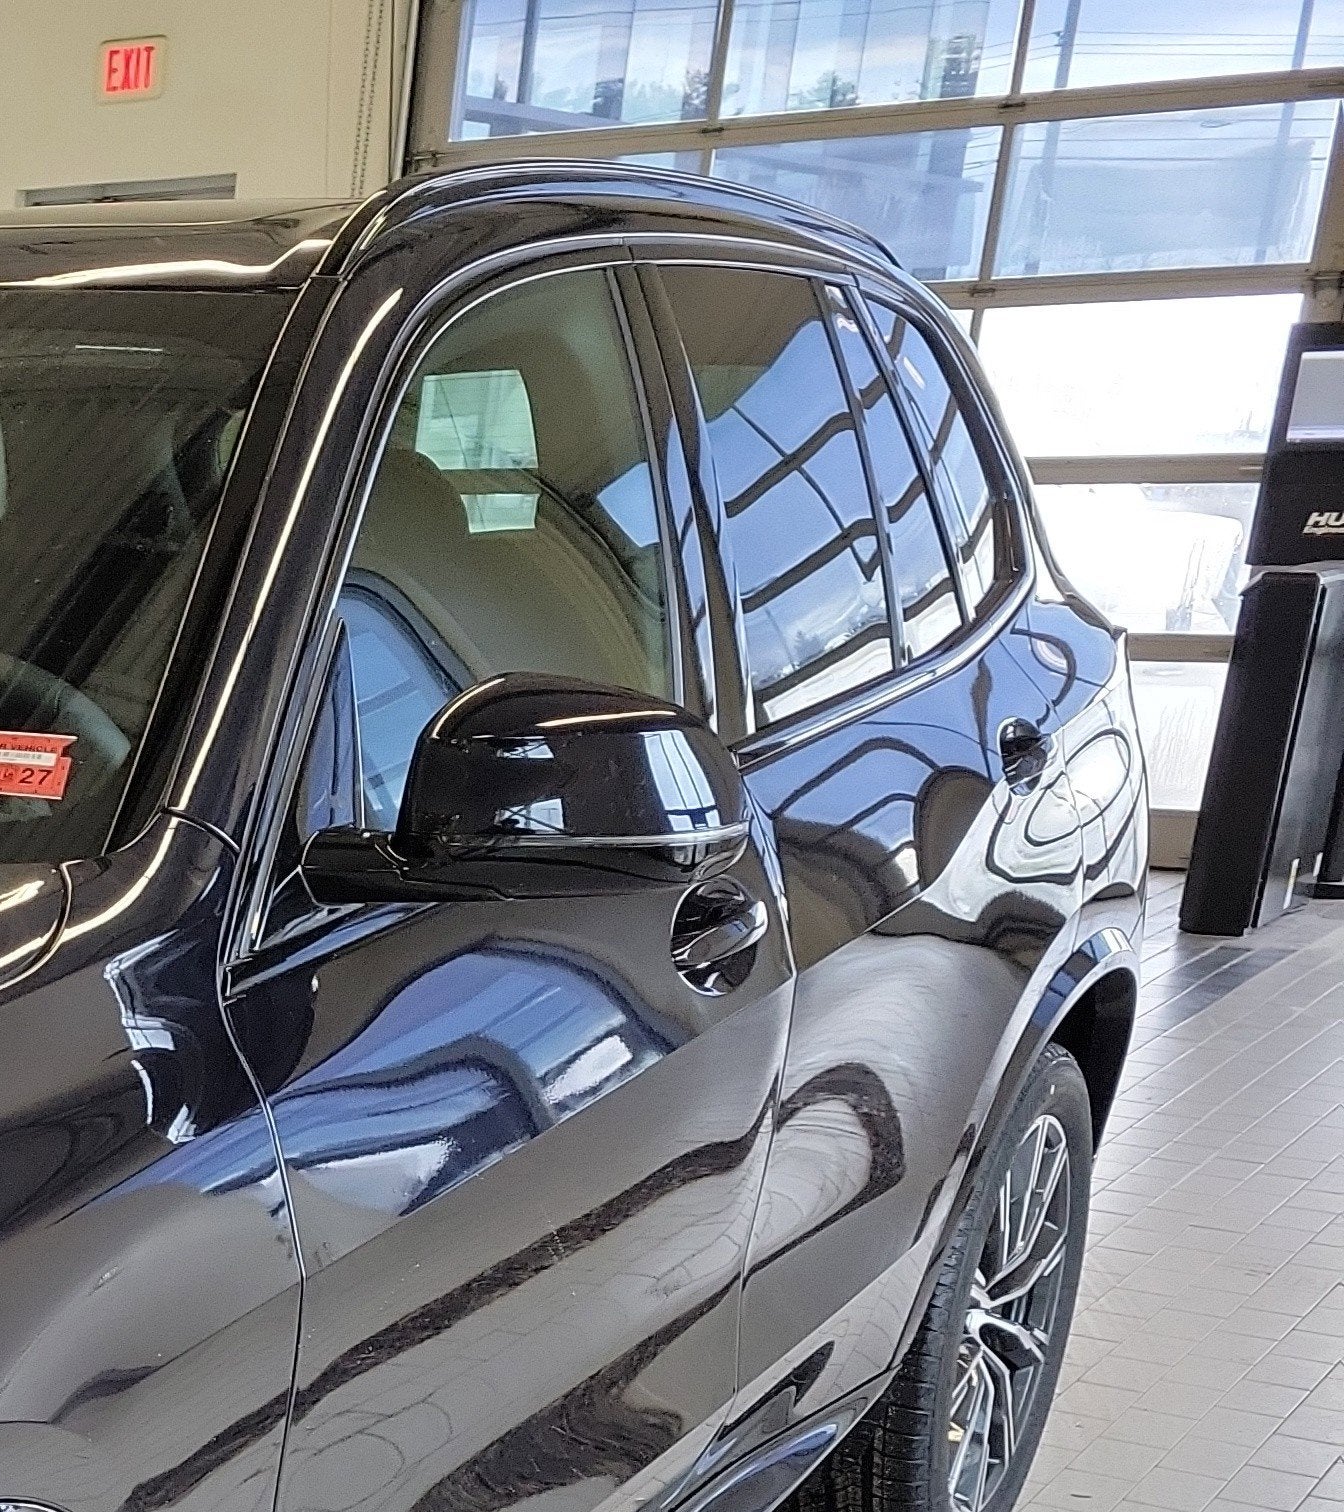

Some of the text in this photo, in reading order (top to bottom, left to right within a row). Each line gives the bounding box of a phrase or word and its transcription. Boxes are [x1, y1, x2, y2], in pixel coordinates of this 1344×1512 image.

[106, 46, 155, 92] EXIT
[11, 744, 58, 753] VEHICLE
[18, 767, 53, 786] 27
